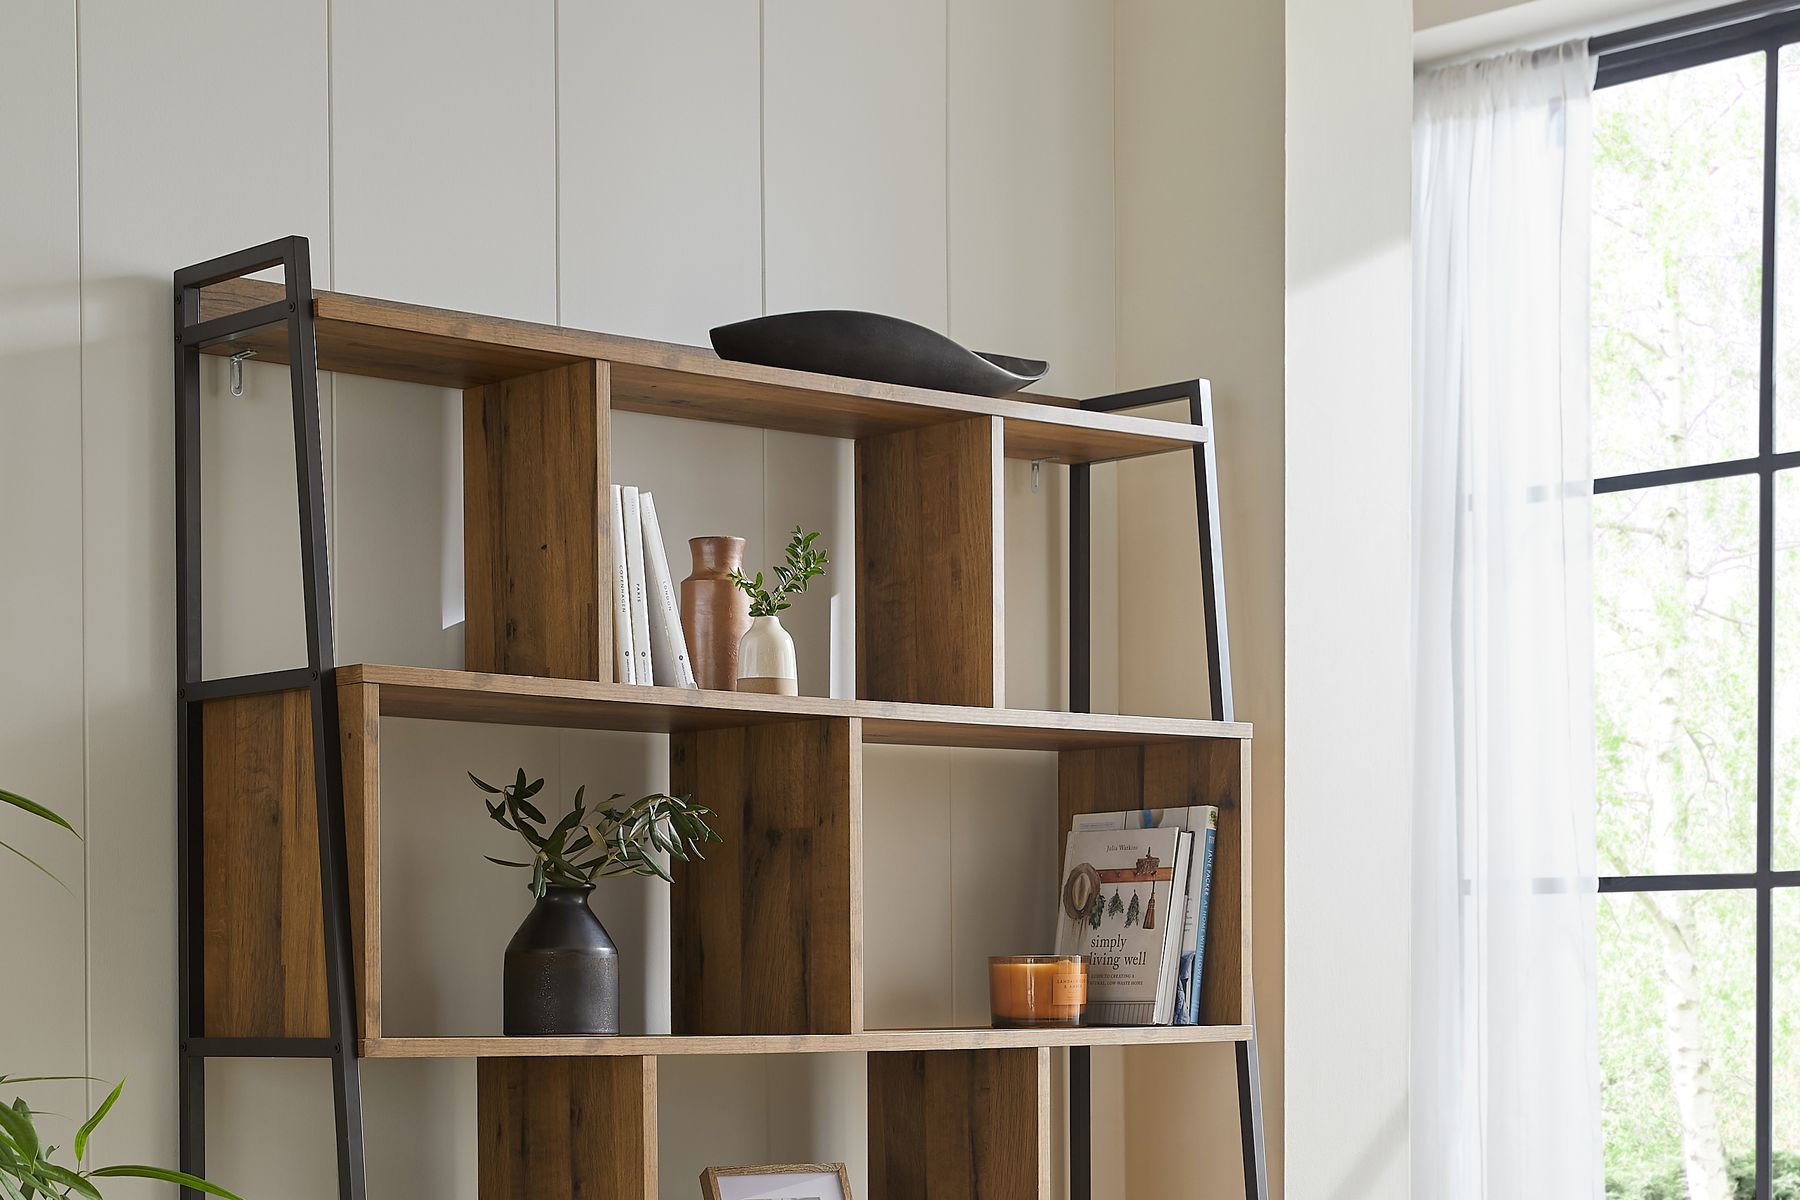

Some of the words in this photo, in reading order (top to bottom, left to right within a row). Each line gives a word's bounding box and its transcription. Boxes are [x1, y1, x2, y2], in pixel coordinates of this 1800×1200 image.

[662, 580, 672, 611] LONDON
[1106, 844, 1118, 852] Julia
[1090, 933, 1127, 952] simply
[1089, 951, 1121, 970] living
[1124, 951, 1147, 966] well
